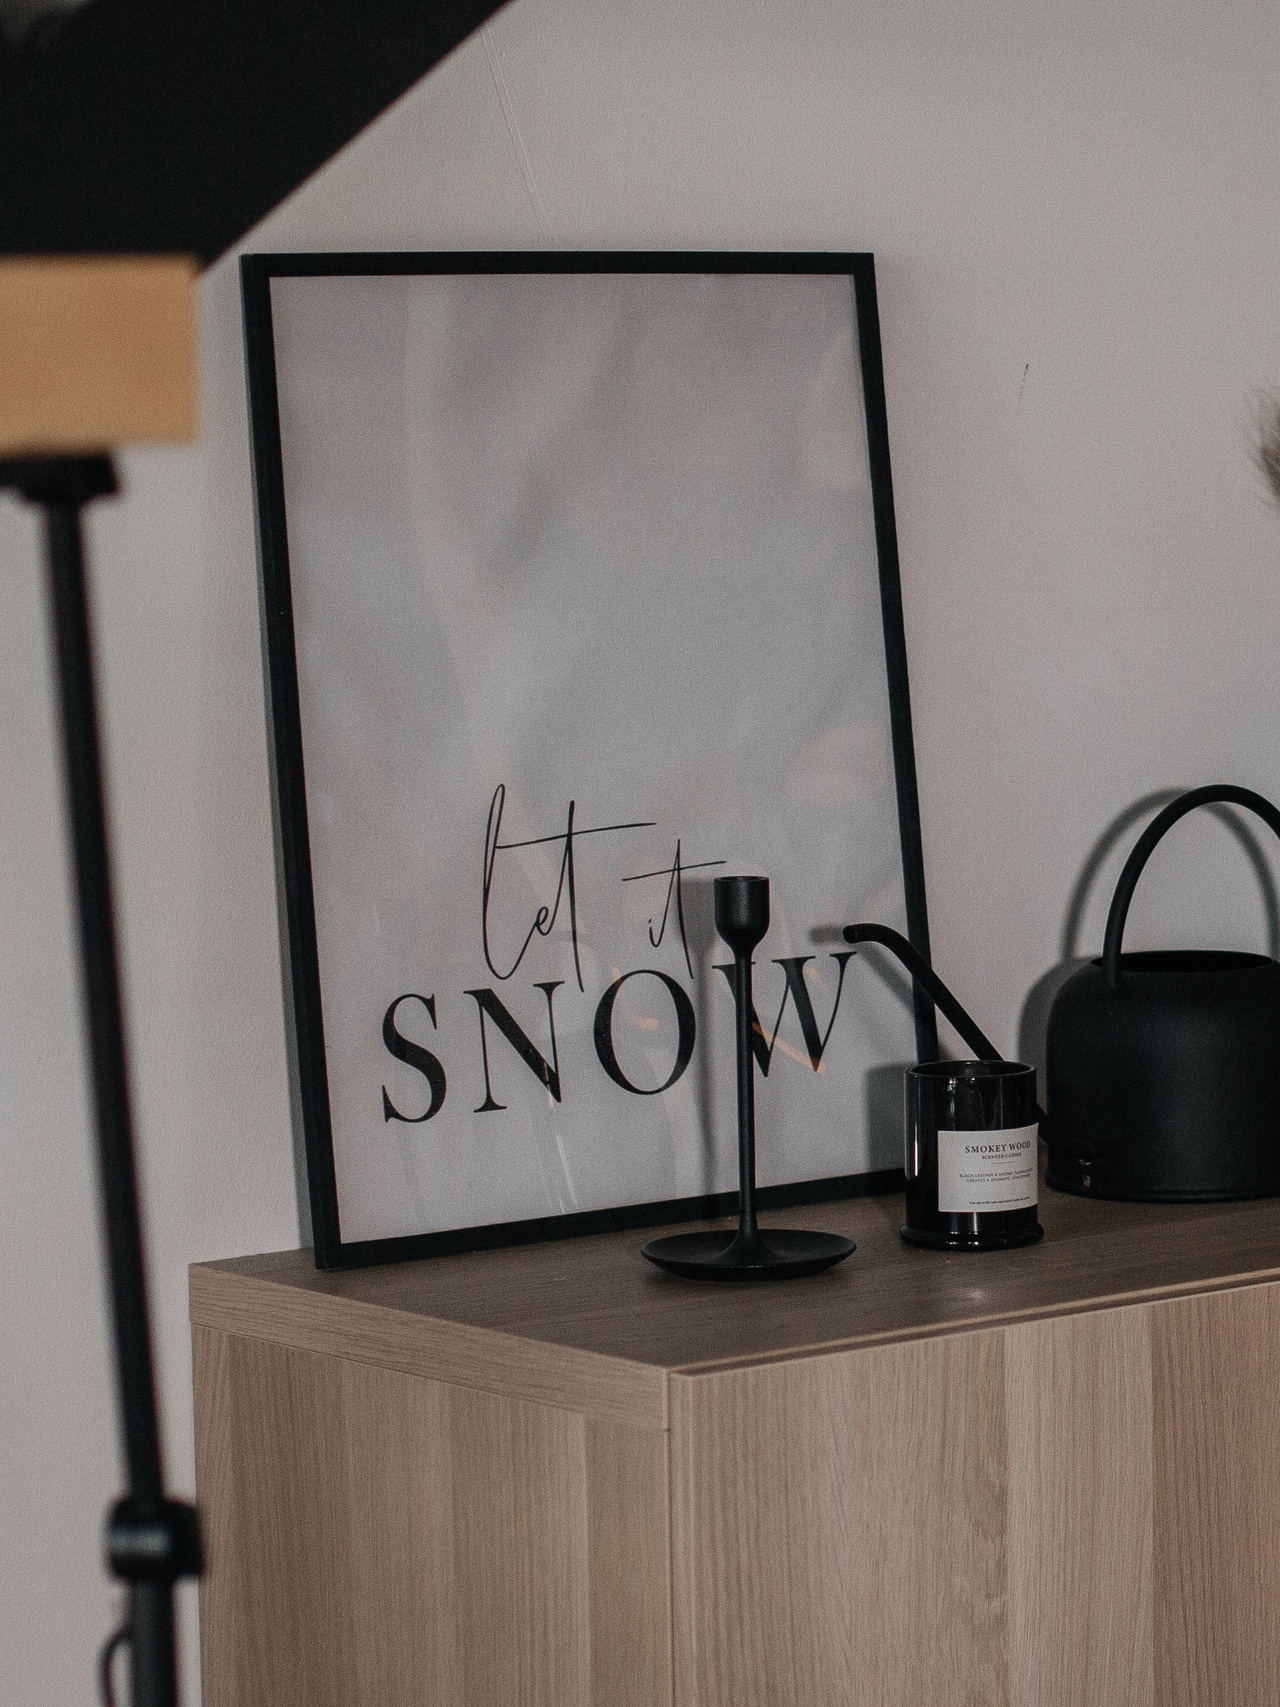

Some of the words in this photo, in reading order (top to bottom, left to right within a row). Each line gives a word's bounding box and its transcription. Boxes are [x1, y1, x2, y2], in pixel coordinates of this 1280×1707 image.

[621, 837, 728, 980] it
[381, 950, 858, 1124] SNOW
[965, 1144, 1007, 1154] SMOKEY
[1009, 1140, 1031, 1151] WOOD
